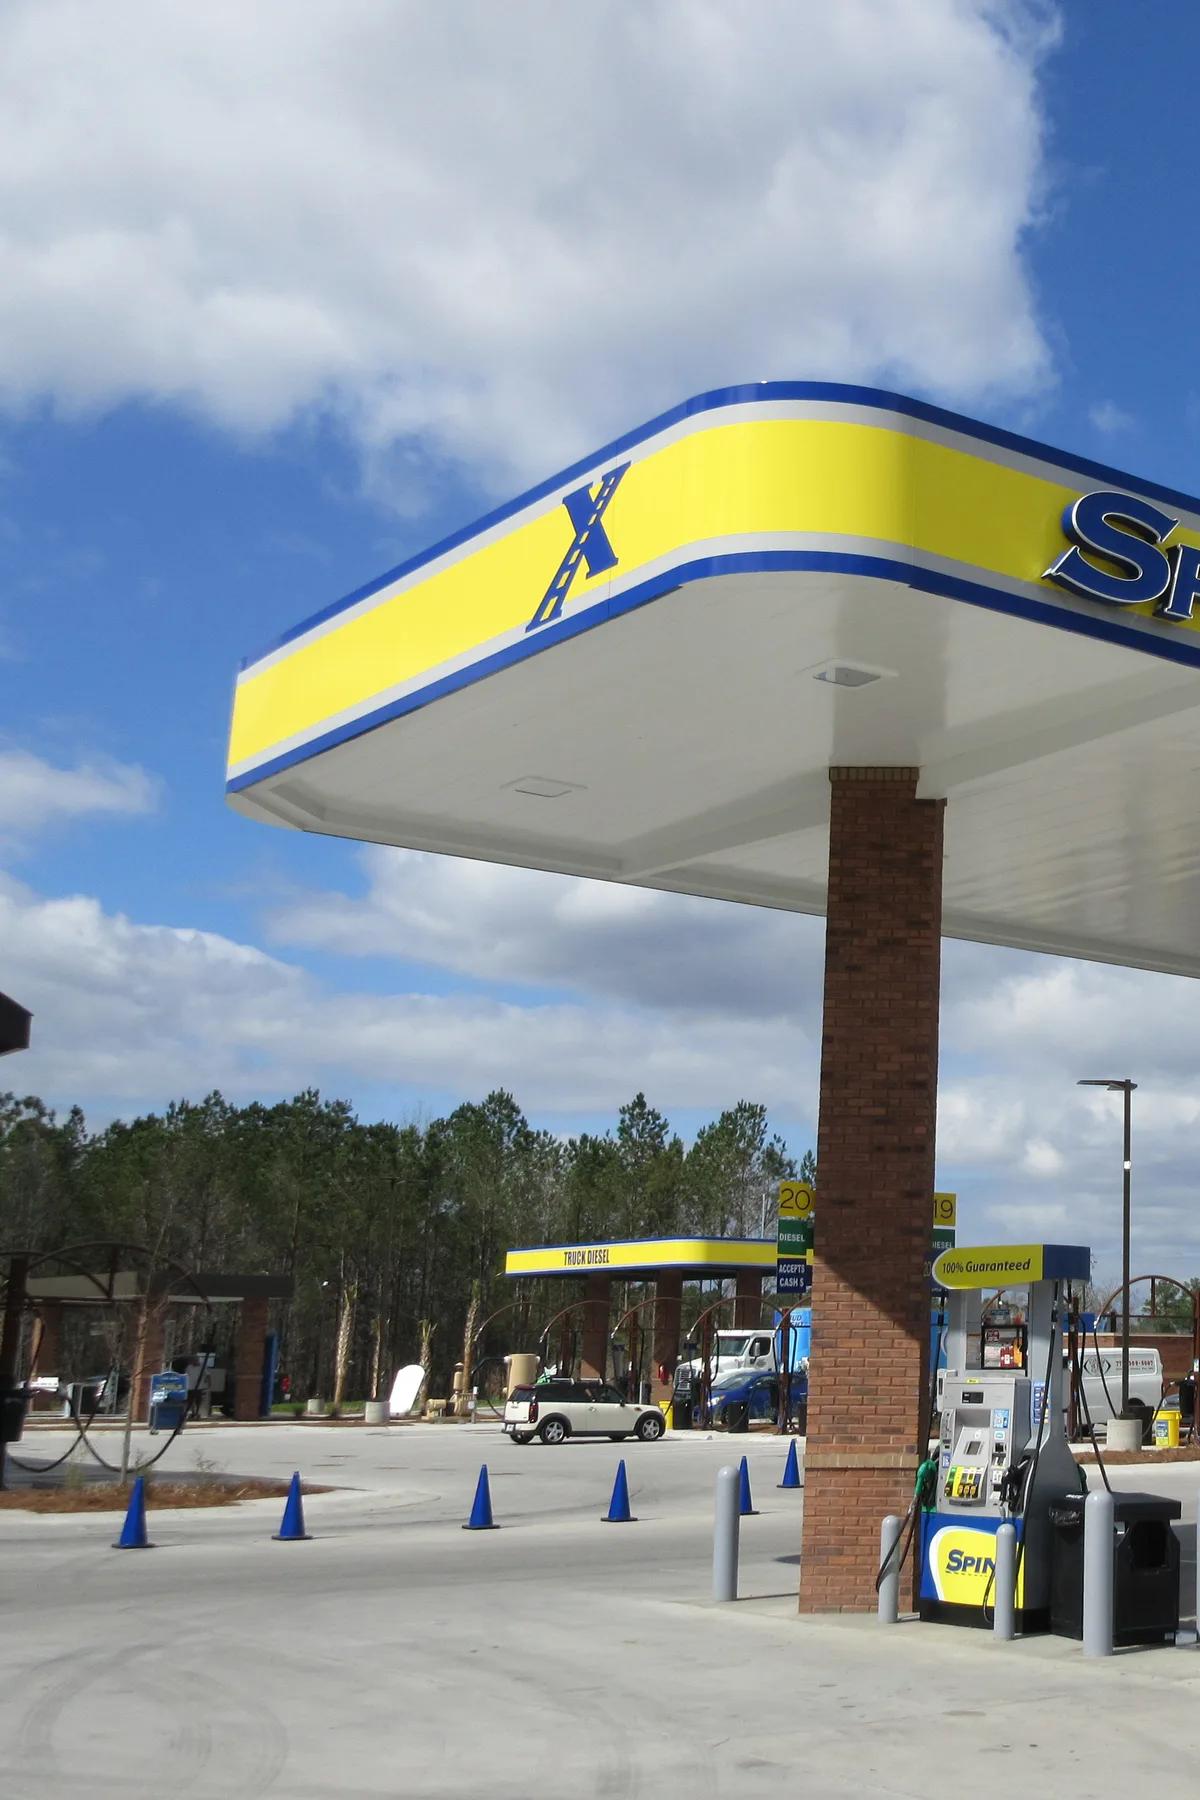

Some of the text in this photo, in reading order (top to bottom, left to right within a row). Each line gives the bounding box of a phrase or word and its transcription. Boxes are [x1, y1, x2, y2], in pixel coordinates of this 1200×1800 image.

[525, 460, 632, 633] X
[780, 1189, 811, 1210] 20
[934, 1199, 954, 1219] 19
[779, 1232, 806, 1242] DIESEL
[932, 1241, 952, 1249] IESEL
[564, 1249, 610, 1266] TRUCK DIESEL
[779, 1264, 806, 1274] ACCEPTS
[943, 1261, 964, 1274] 100%
[965, 1258, 1032, 1273] Guaranteed
[779, 1277, 799, 1287] CASH
[946, 1549, 996, 1573] SPIN
